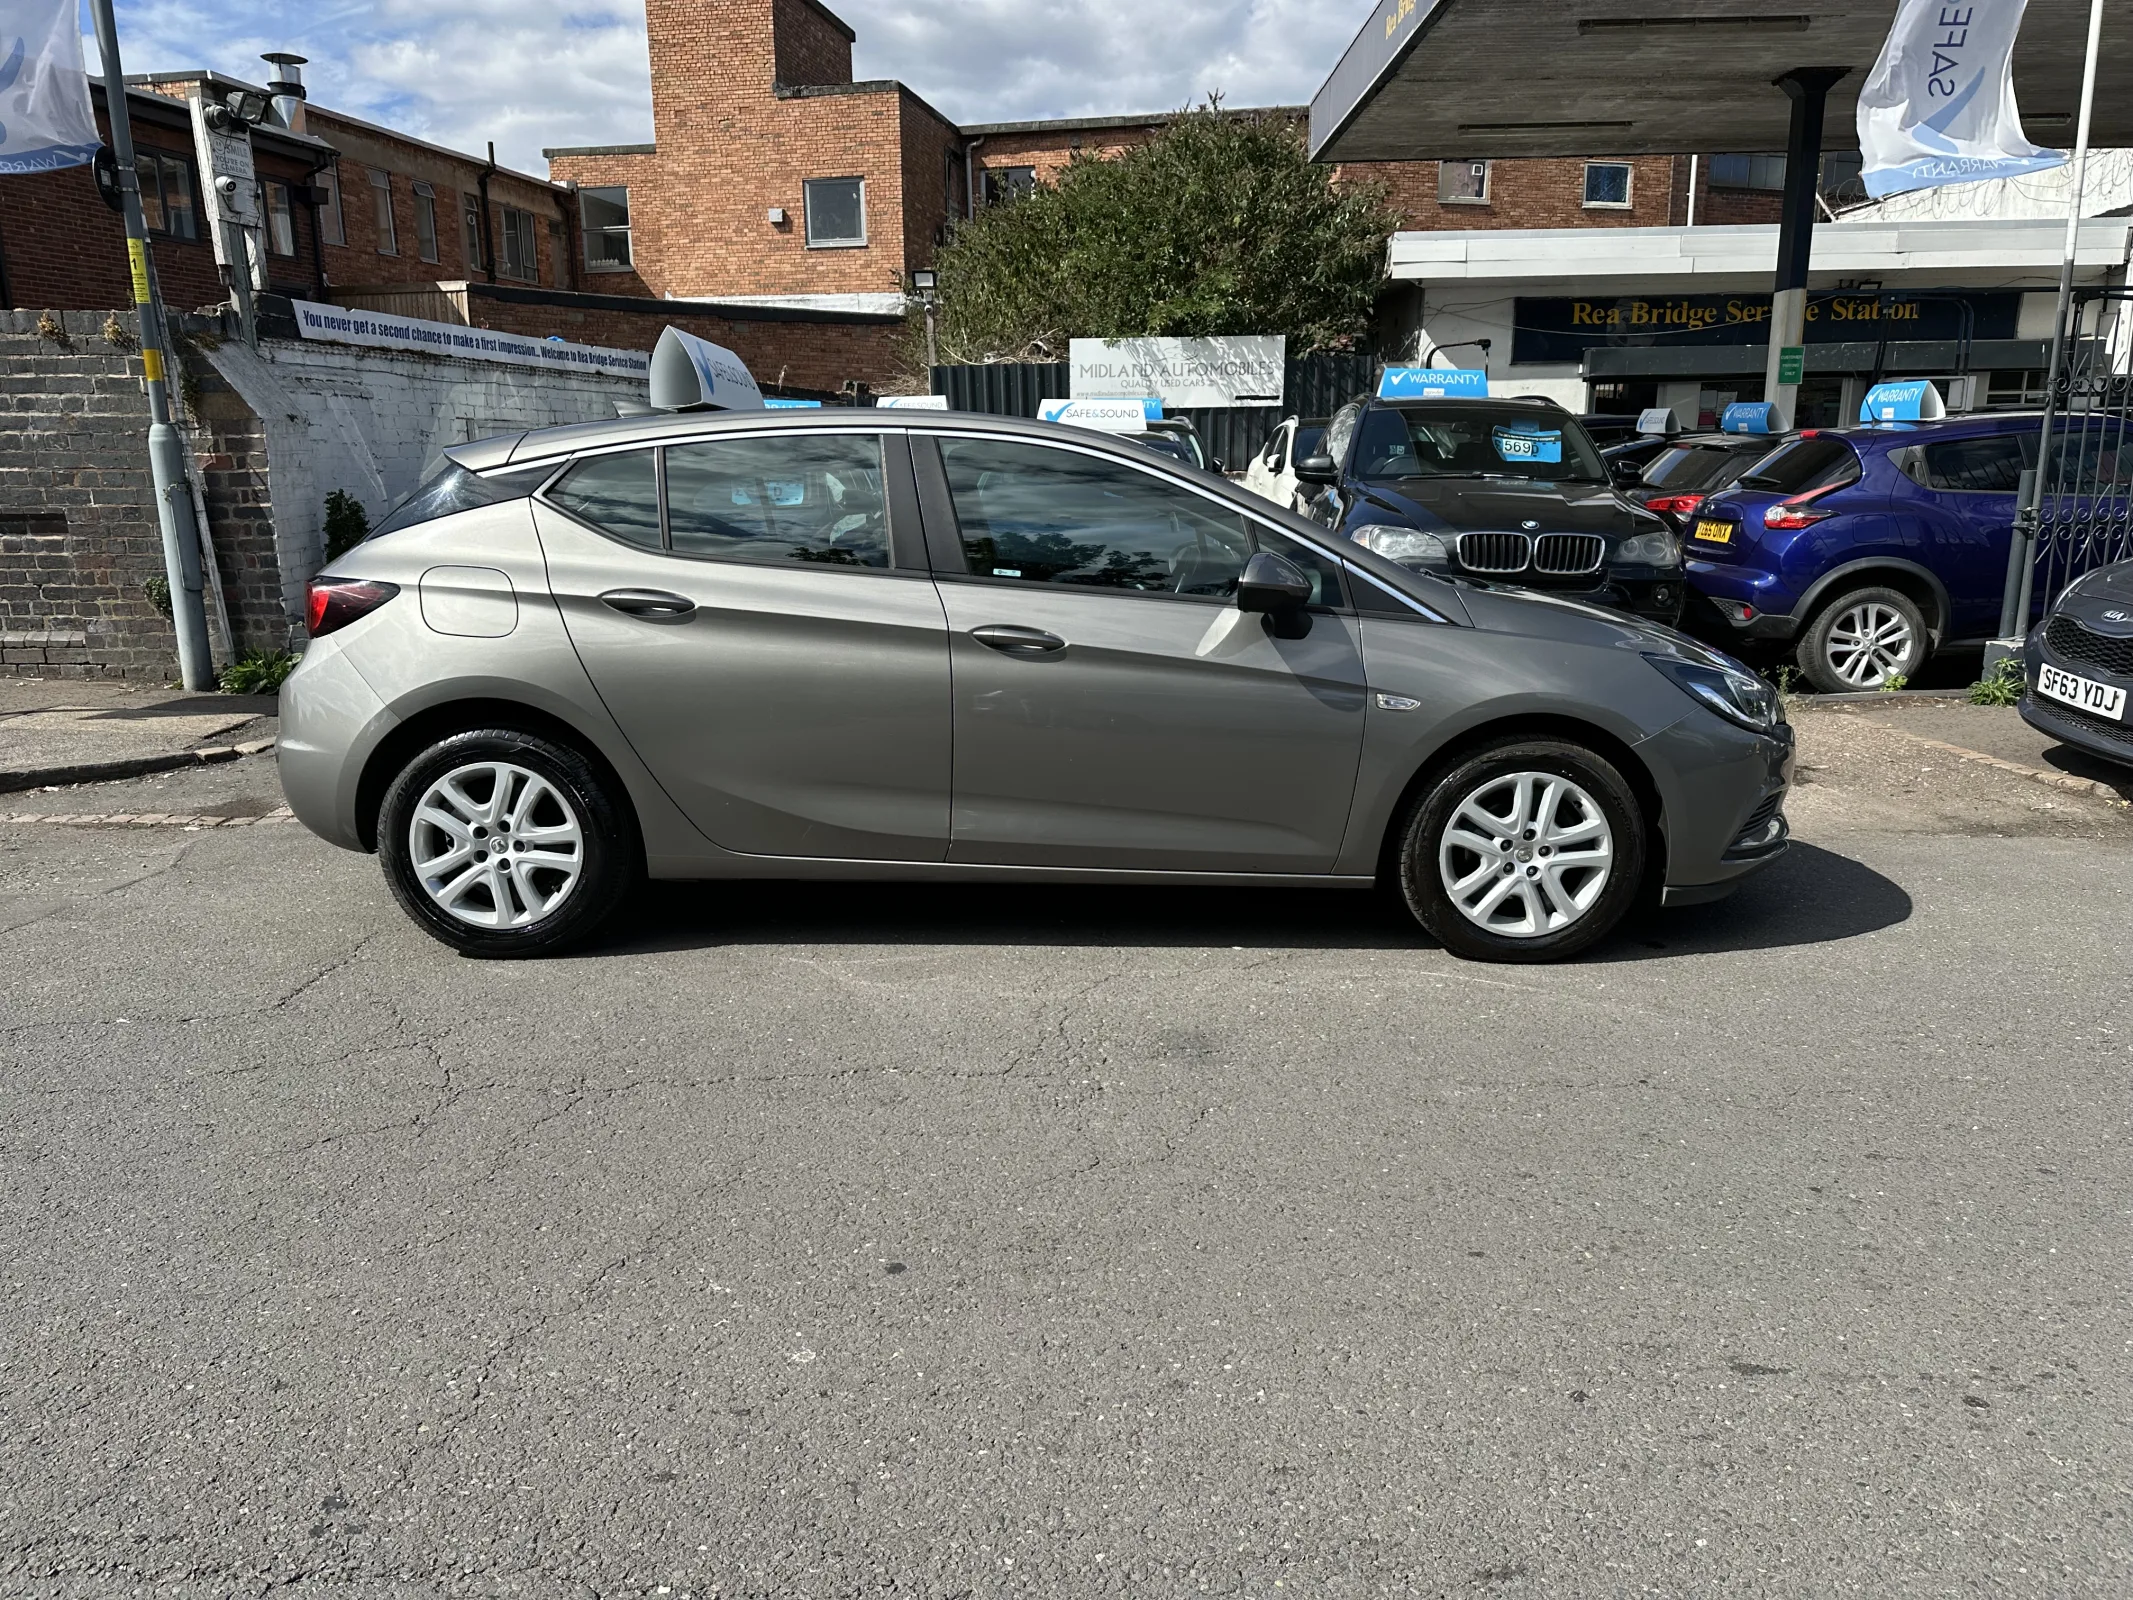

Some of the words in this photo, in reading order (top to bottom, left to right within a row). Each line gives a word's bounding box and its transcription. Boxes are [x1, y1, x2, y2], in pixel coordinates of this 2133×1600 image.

[226, 144, 248, 158] SMILE
[221, 163, 247, 174] CAMERA
[240, 160, 250, 168] ON
[1571, 302, 1620, 324] Rea
[1631, 301, 1717, 329] Bridge
[1725, 300, 1819, 322] Sere
[1831, 298, 1920, 320] Staton
[303, 310, 322, 328] You
[324, 316, 351, 331] never
[354, 320, 369, 335] get
[370, 323, 376, 334] a
[378, 323, 410, 340] second
[412, 327, 442, 344] chance
[443, 332, 451, 344] to
[453, 334, 474, 348] make
[476, 339, 480, 349] a
[481, 337, 497, 350] first
[540, 346, 569, 362] Welcome
[570, 352, 576, 362] to
[578, 352, 588, 363] Rea
[589, 353, 608, 366] Bridge
[608, 354, 628, 368] Service
[629, 357, 646, 370] Station
[1080, 364, 1154, 378] MIDLAND
[1160, 362, 1274, 377] AUTOMOBILES
[1121, 379, 1158, 388] QUALITY
[1160, 379, 1180, 388] USED
[1183, 378, 1206, 387] CARS
[1409, 373, 1480, 385] WARRANTY
[1878, 388, 1921, 402] WARRANTY
[1066, 408, 1139, 418] SAFE&SOUND
[1734, 407, 1766, 419] WARRANTY
[2104, 610, 2124, 620] KIA
[2044, 668, 2078, 699] SF63
[2084, 682, 2118, 712] YDJ
